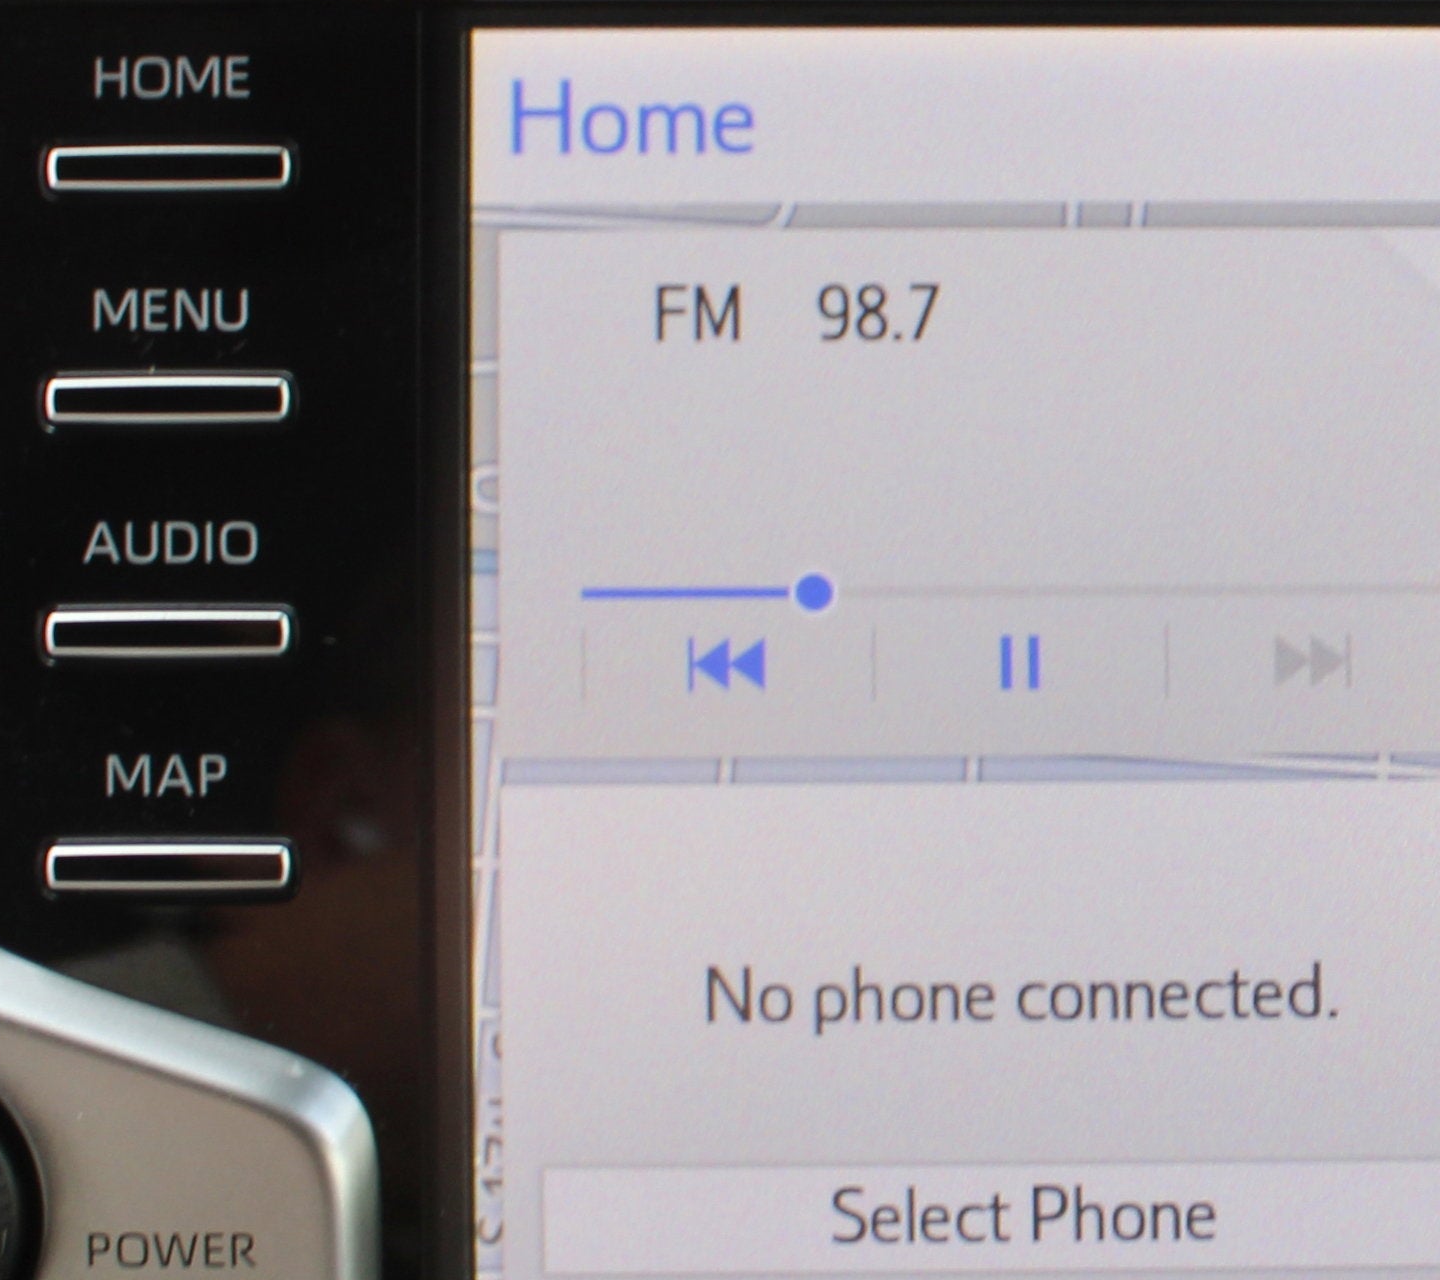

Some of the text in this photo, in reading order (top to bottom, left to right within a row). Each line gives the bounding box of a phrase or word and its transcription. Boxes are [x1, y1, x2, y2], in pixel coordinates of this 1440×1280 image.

[94, 55, 251, 99] HOME
[510, 78, 755, 155] Home
[93, 288, 250, 332] MENU
[654, 283, 941, 343] FM 98.7
[83, 520, 260, 565] AUDIO
[105, 753, 229, 798] MAP
[705, 959, 1341, 1036] No phone connected.
[831, 1183, 1217, 1245] Select Phone
[87, 1231, 257, 1267] POWER
